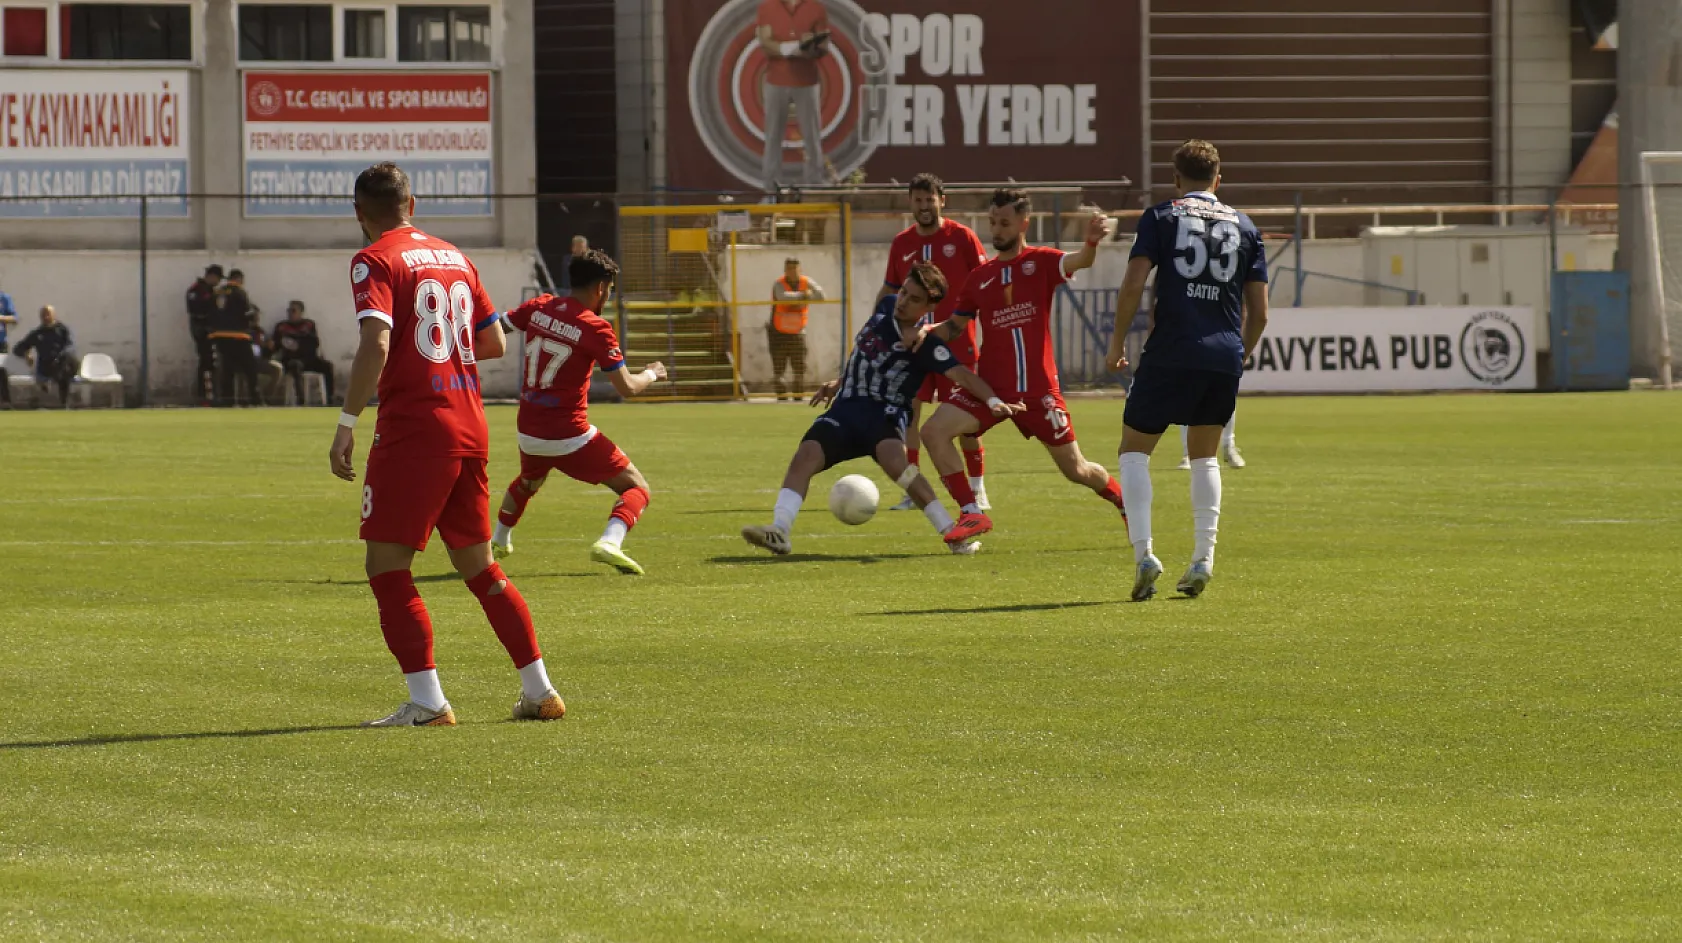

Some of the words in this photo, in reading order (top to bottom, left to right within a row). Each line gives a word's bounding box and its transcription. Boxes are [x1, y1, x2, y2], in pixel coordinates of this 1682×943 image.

[859, 12, 984, 76] SPOR
[23, 80, 179, 147] KAYMAKAMLIĞI
[285, 89, 308, 108] T.C.
[310, 87, 365, 113] GENÇLİK
[367, 90, 385, 108] VE
[388, 90, 420, 109] SPOR
[422, 86, 487, 108] BAKANLIĞI
[859, 84, 945, 146] HER
[956, 83, 1097, 146] YERDE
[345, 132, 360, 151] VE
[361, 131, 390, 151] SPOR
[1173, 216, 1241, 282] 53
[1186, 282, 1220, 300] SATIR
[414, 278, 477, 364] 88
[526, 335, 573, 390] 17
[1391, 335, 1452, 369] PUB
[1045, 407, 1068, 430] 10
[362, 484, 373, 519] 8
